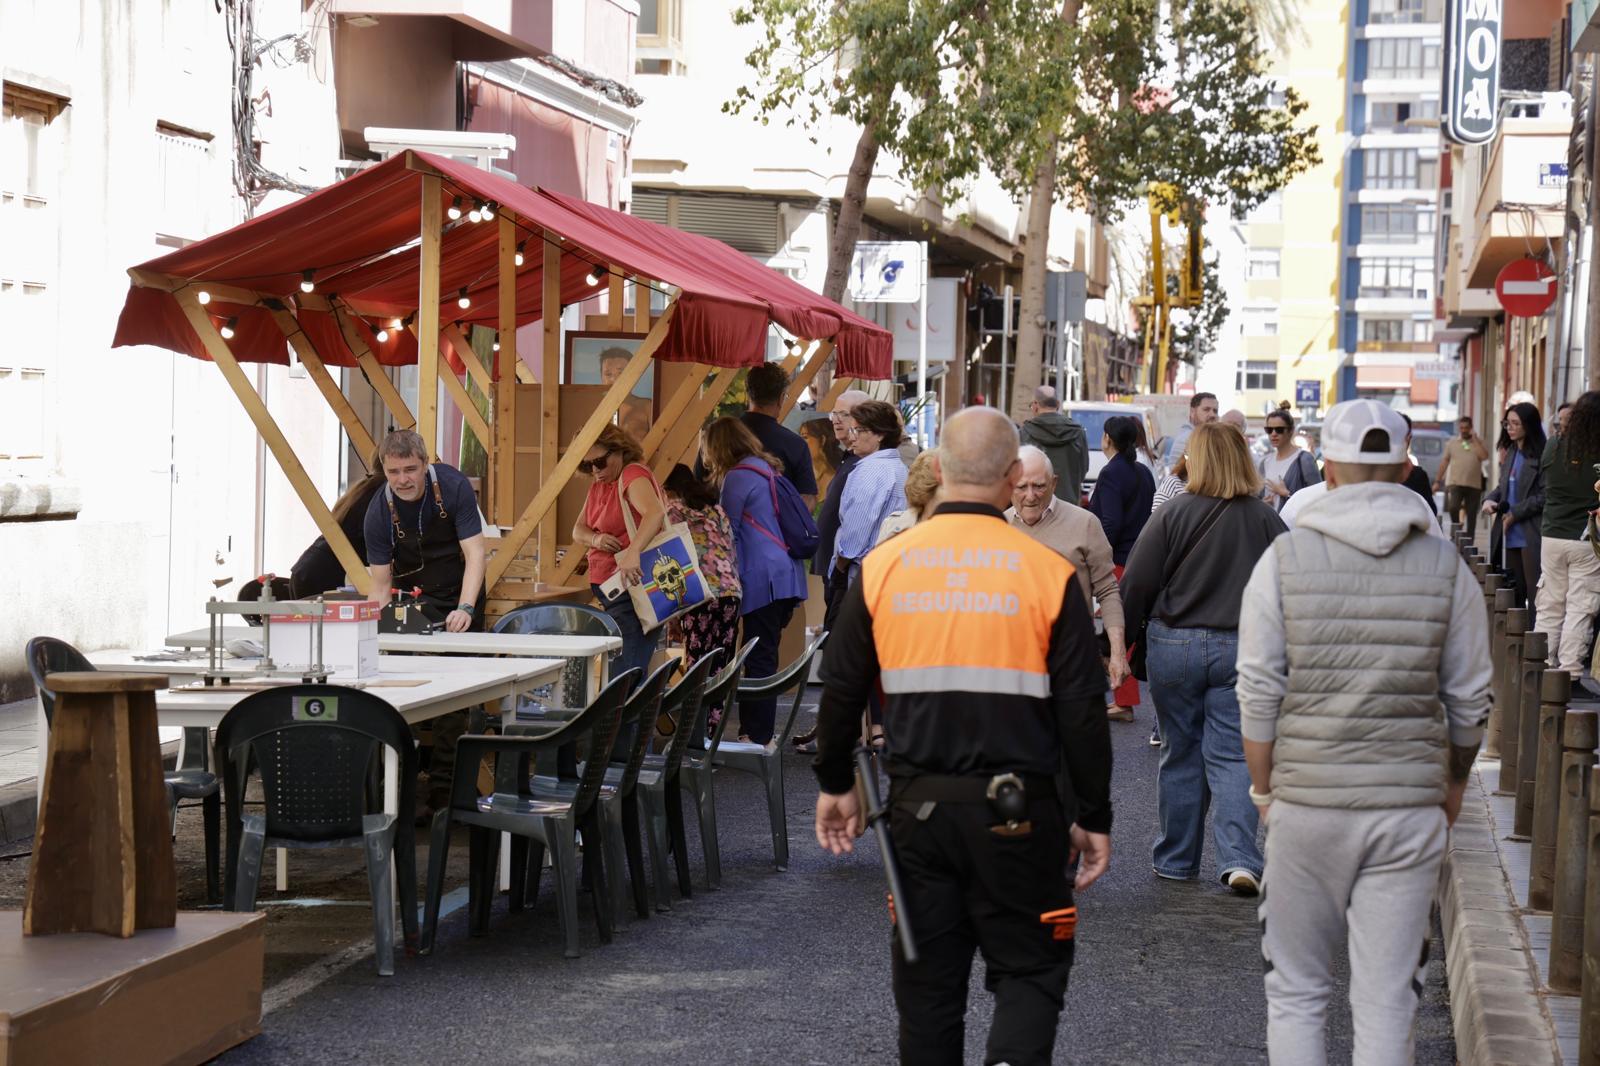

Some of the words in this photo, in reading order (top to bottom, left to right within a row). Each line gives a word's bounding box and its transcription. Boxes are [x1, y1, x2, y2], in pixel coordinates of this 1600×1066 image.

[900, 546, 1022, 573] VIGILANTE
[946, 571, 969, 589] DE
[892, 591, 1020, 616] SEGURIDAD
[310, 701, 321, 714] 6
